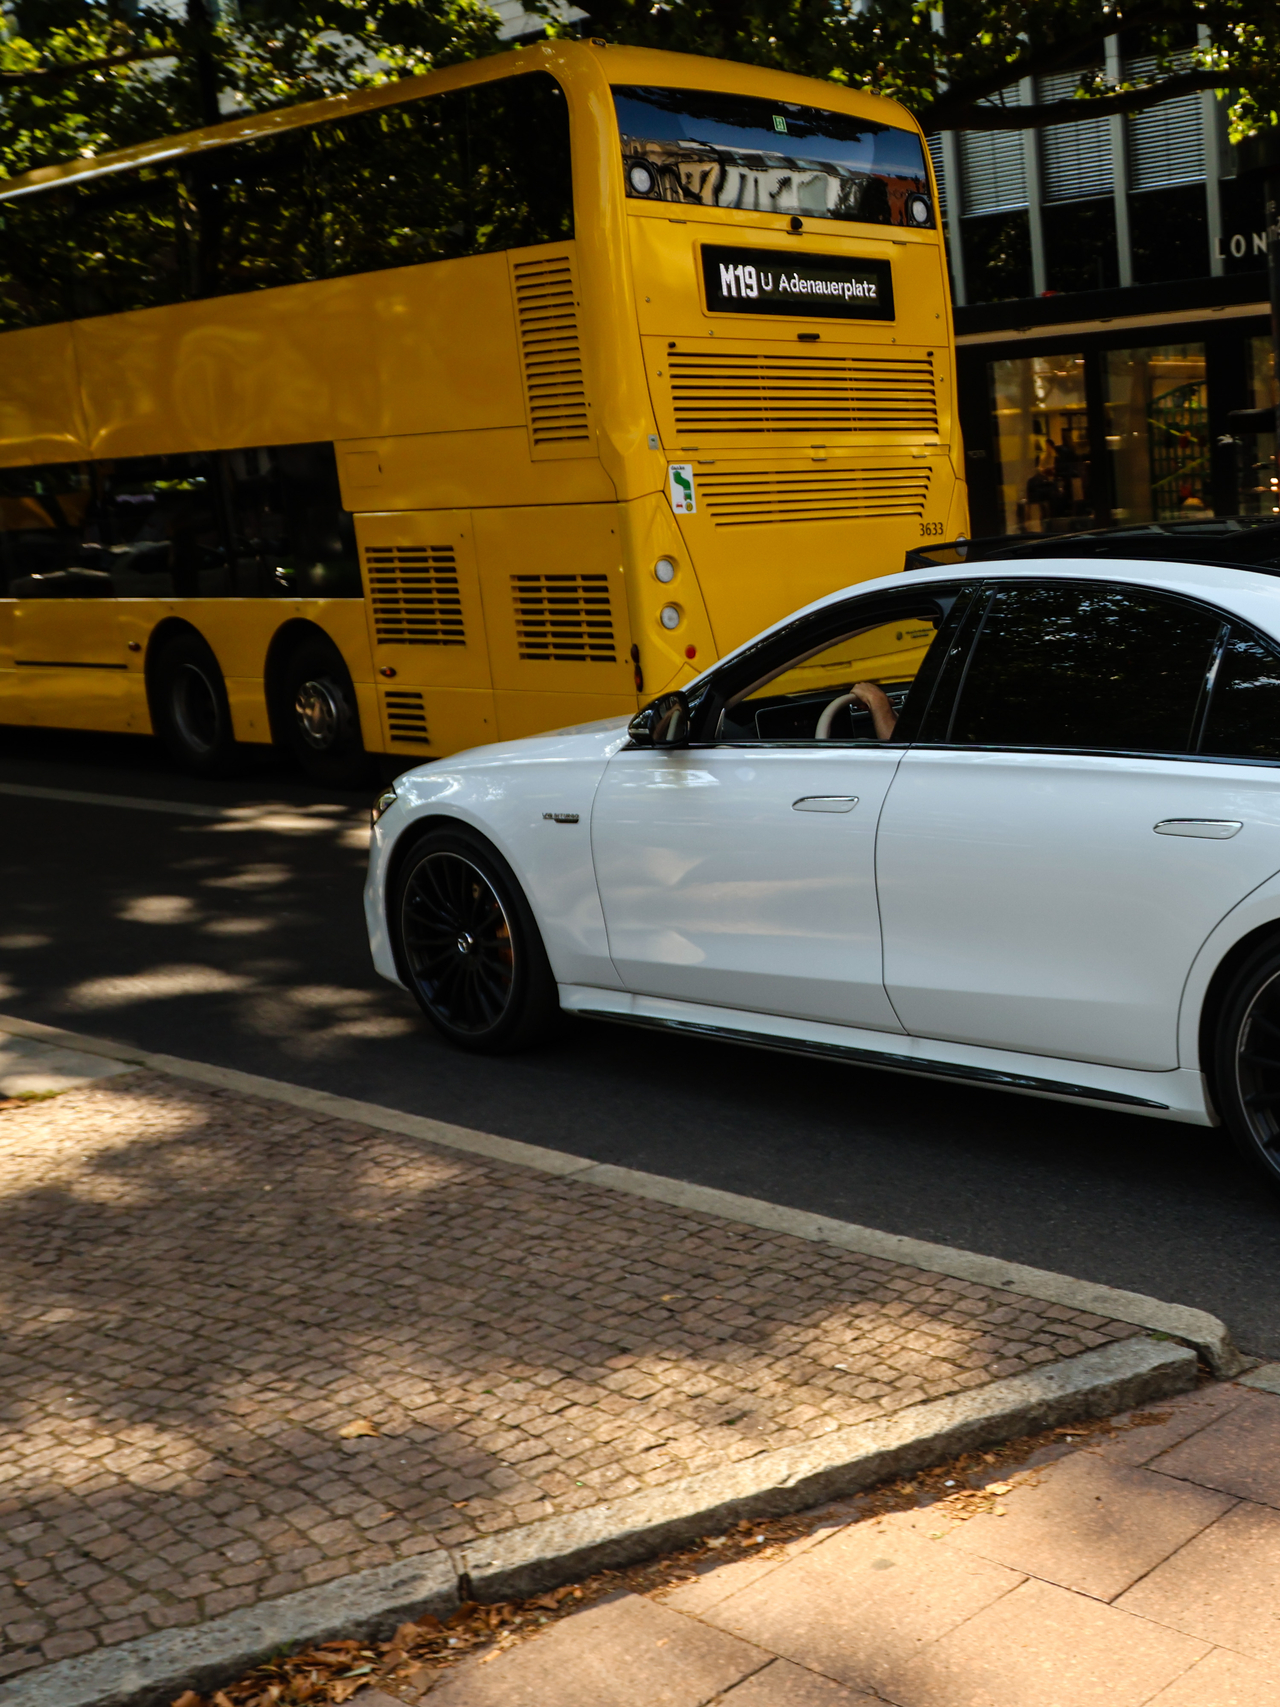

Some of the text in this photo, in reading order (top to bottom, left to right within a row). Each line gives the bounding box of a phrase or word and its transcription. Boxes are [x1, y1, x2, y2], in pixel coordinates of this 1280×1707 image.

[719, 263, 877, 301] M19 U Adenauerplatz
[918, 521, 944, 537] 3633
